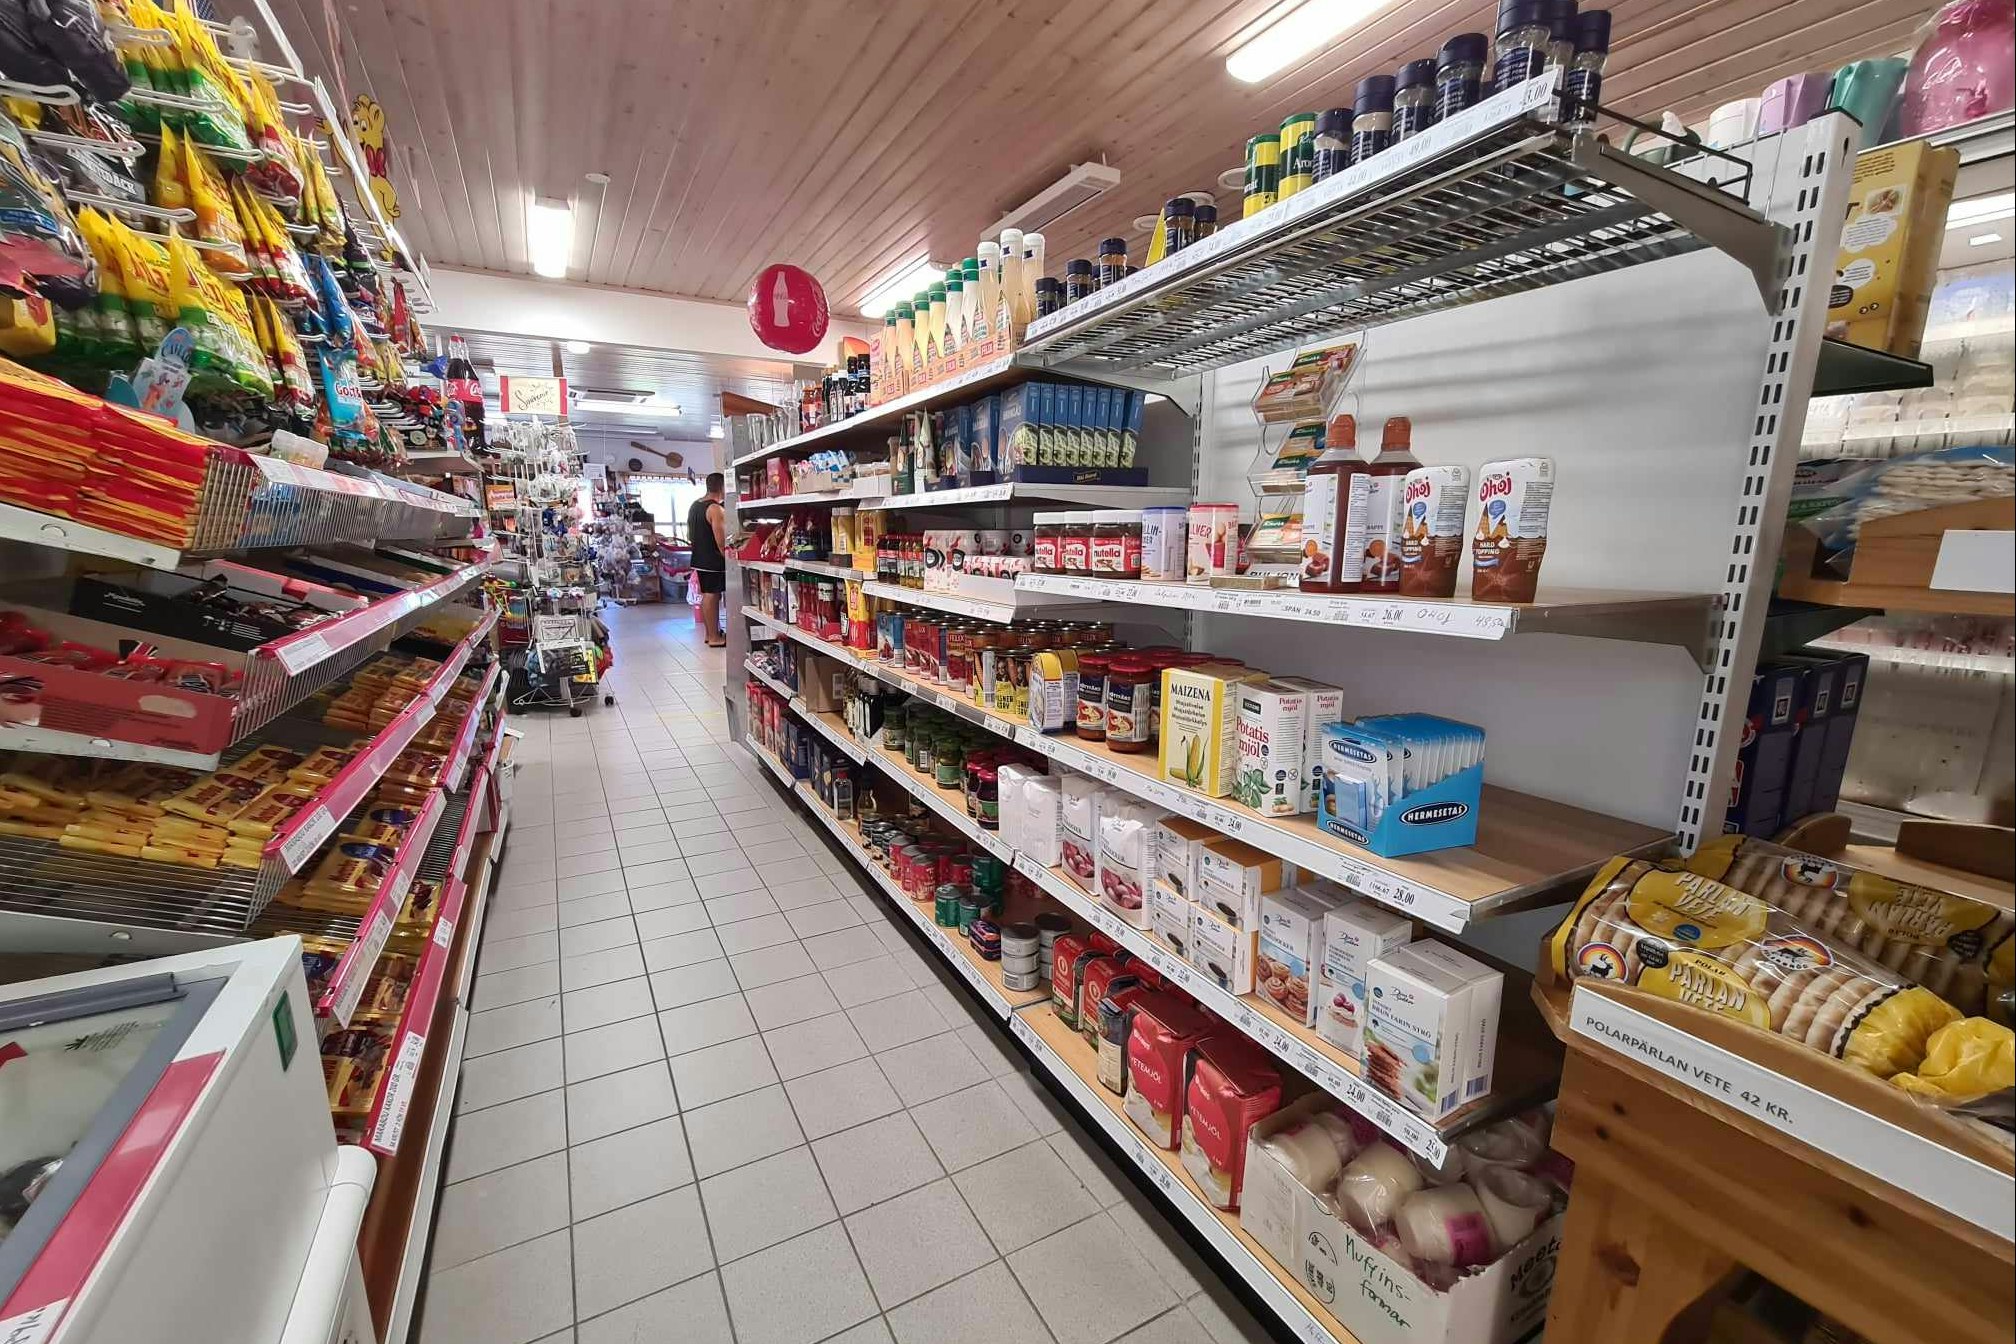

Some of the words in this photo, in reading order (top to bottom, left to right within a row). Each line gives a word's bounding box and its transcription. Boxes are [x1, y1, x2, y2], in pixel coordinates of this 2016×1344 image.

[1170, 682, 1211, 702] MAIZENA
[1235, 715, 1270, 744] Potatis
[1238, 738, 1262, 759] mjöl
[1407, 805, 1464, 822] HERMESETAS
[1393, 887, 1415, 906] 28.00
[1585, 1015, 1689, 1073] POLARPÄRLAN
[1692, 1065, 1732, 1095] VETE
[1740, 1090, 1761, 1107] 42
[1765, 1100, 1794, 1124] KR.
[1346, 1083, 1366, 1103] 24.00
